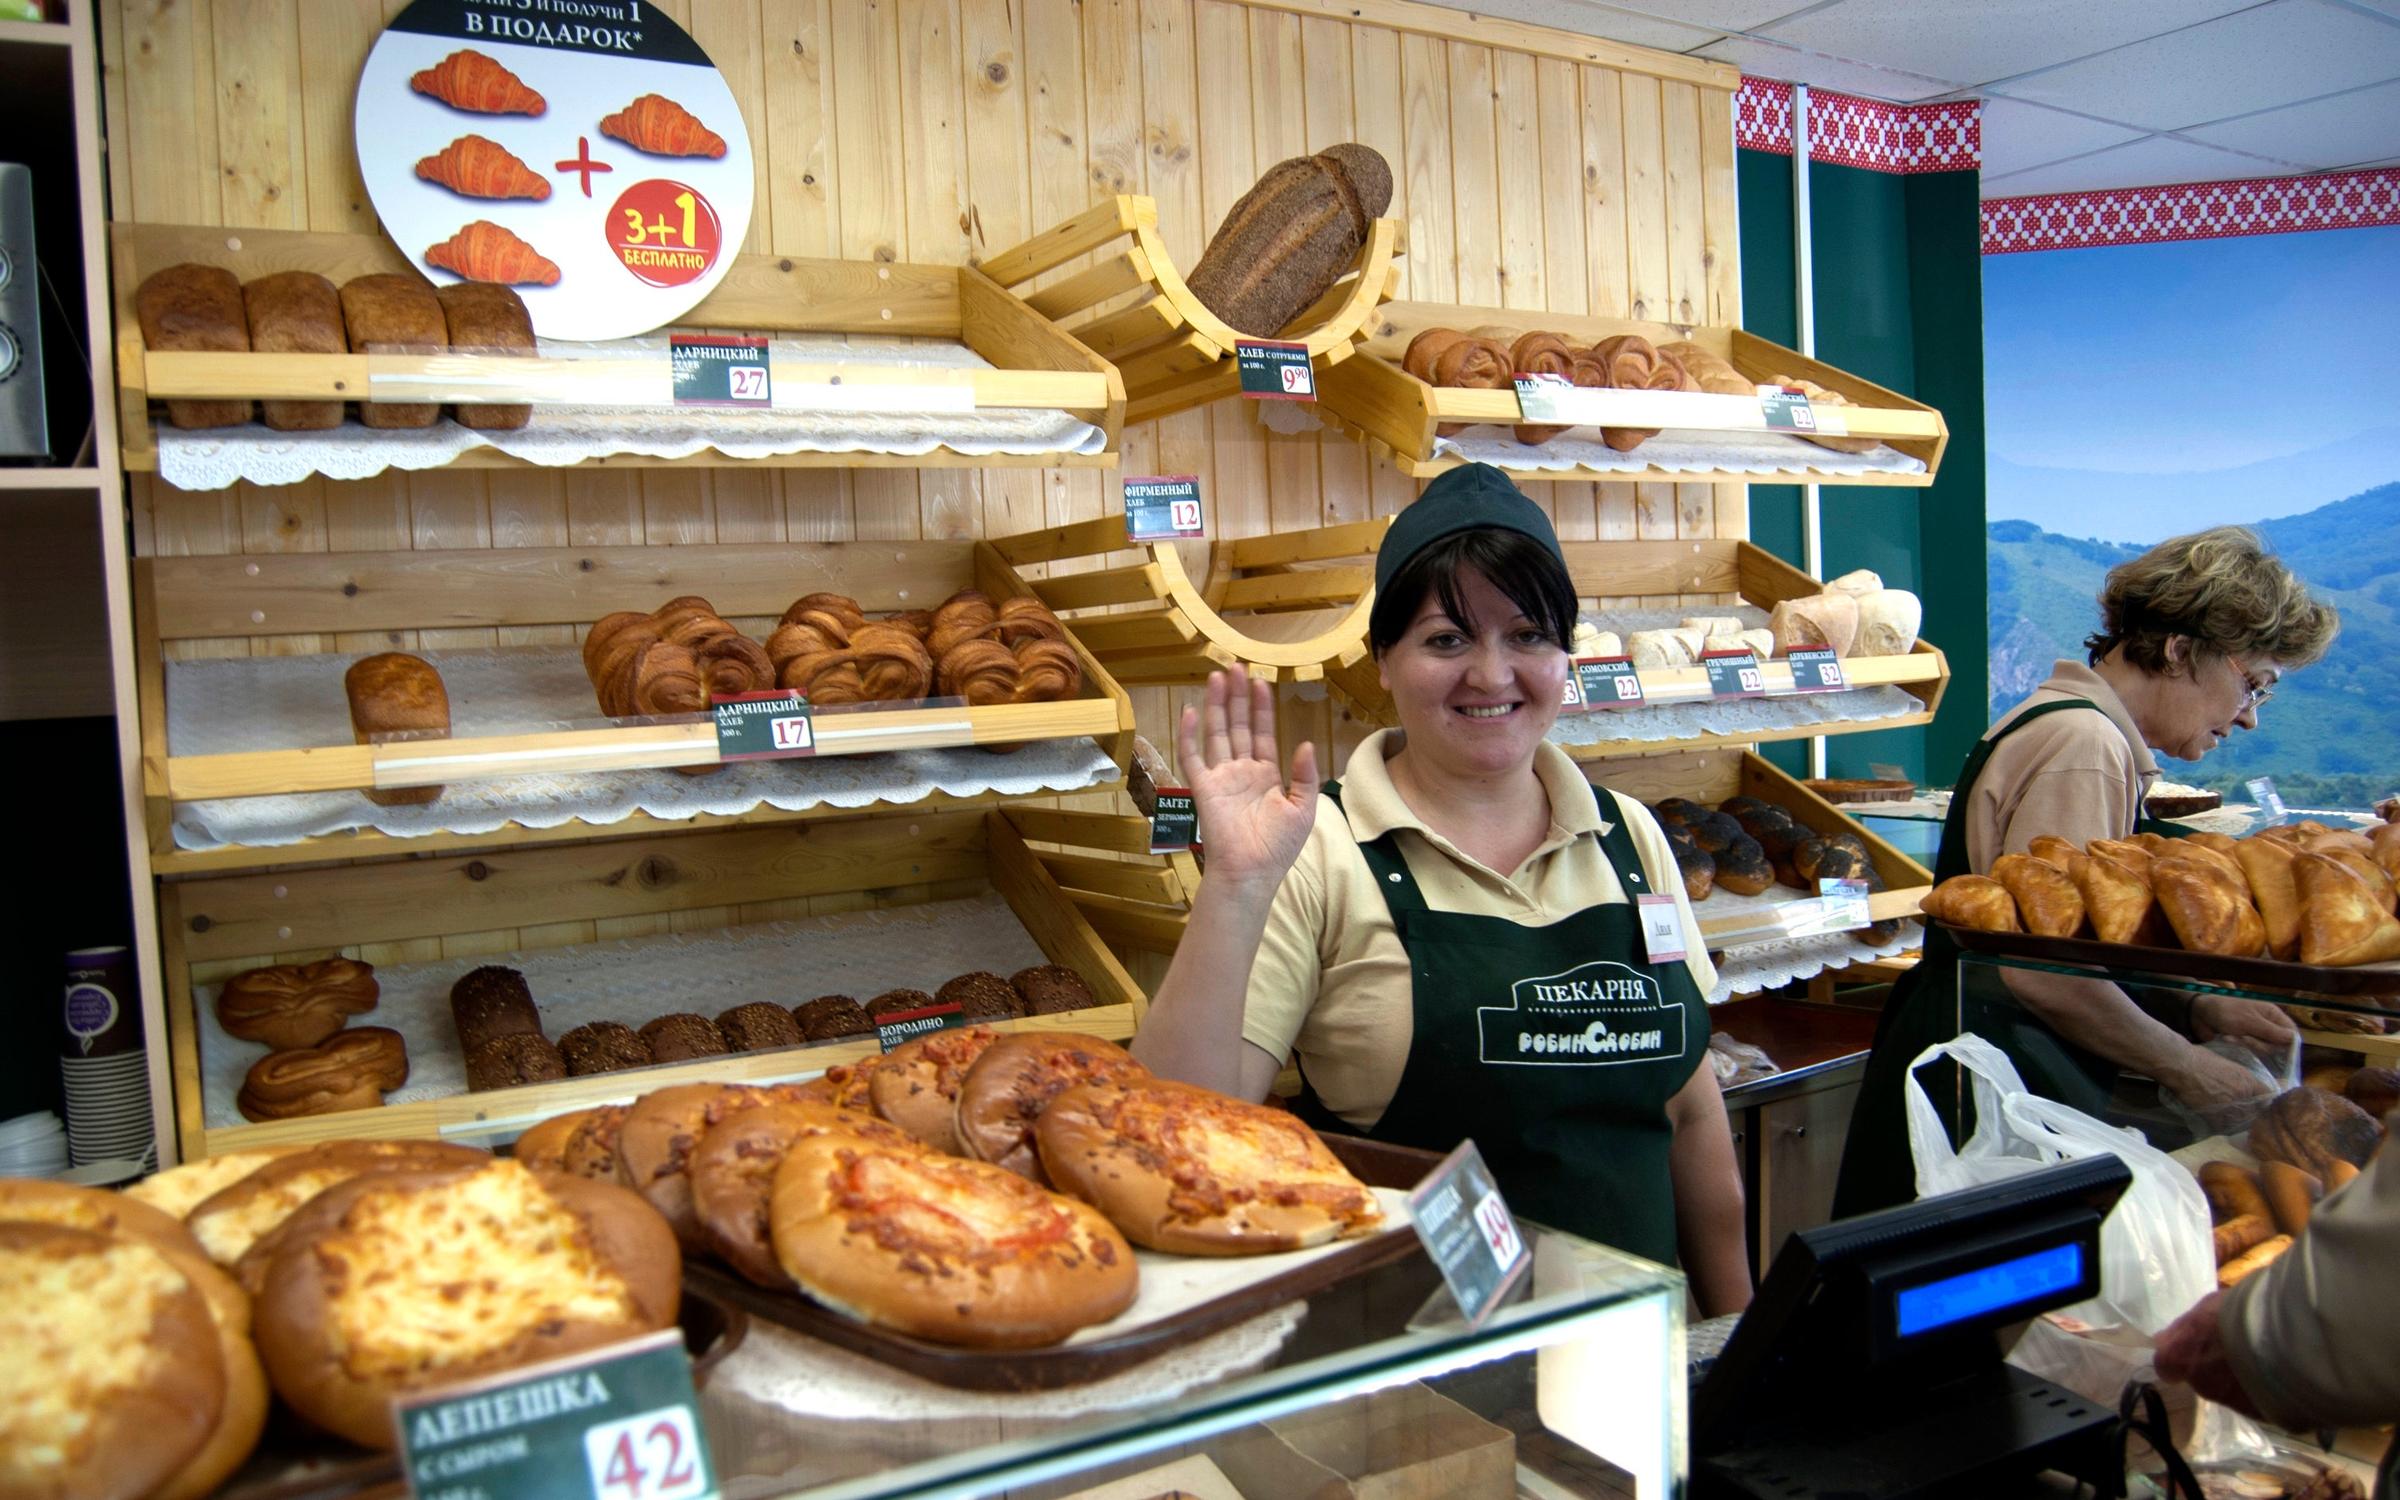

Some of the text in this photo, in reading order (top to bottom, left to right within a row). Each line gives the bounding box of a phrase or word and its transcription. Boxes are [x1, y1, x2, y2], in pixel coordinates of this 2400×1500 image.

[552, 0, 624, 20] ПОЛУЧИ
[630, 2, 642, 22] 1
[465, 12, 483, 32] В
[623, 248, 705, 270] БЕСПЛАТНО
[674, 346, 759, 362] ДАРНИЦКИЙ
[1238, 346, 1265, 359] ХЛЕБ
[1271, 351, 1307, 361] ОТРУБЯМИ
[732, 370, 764, 396] 27
[1124, 482, 1193, 497] ФИРМЕННЫЙ
[1126, 498, 1145, 507] ХЛЕБ
[1173, 503, 1198, 526] 12
[1741, 671, 1761, 689] 22
[1821, 665, 1840, 683] 32
[1617, 678, 1638, 697] 22
[718, 697, 800, 717] ДАРНИЦКИЙ
[720, 716, 744, 727] ХЛЕБ
[775, 720, 805, 745] 17
[1158, 797, 1191, 809] БАГЕТ
[1532, 979, 1648, 1003] ПЕКАРНЯ
[880, 1017, 944, 1037] БОРОДИНО
[413, 1371, 612, 1448] ЛЕПЕШКА
[603, 1419, 696, 1499] 42
